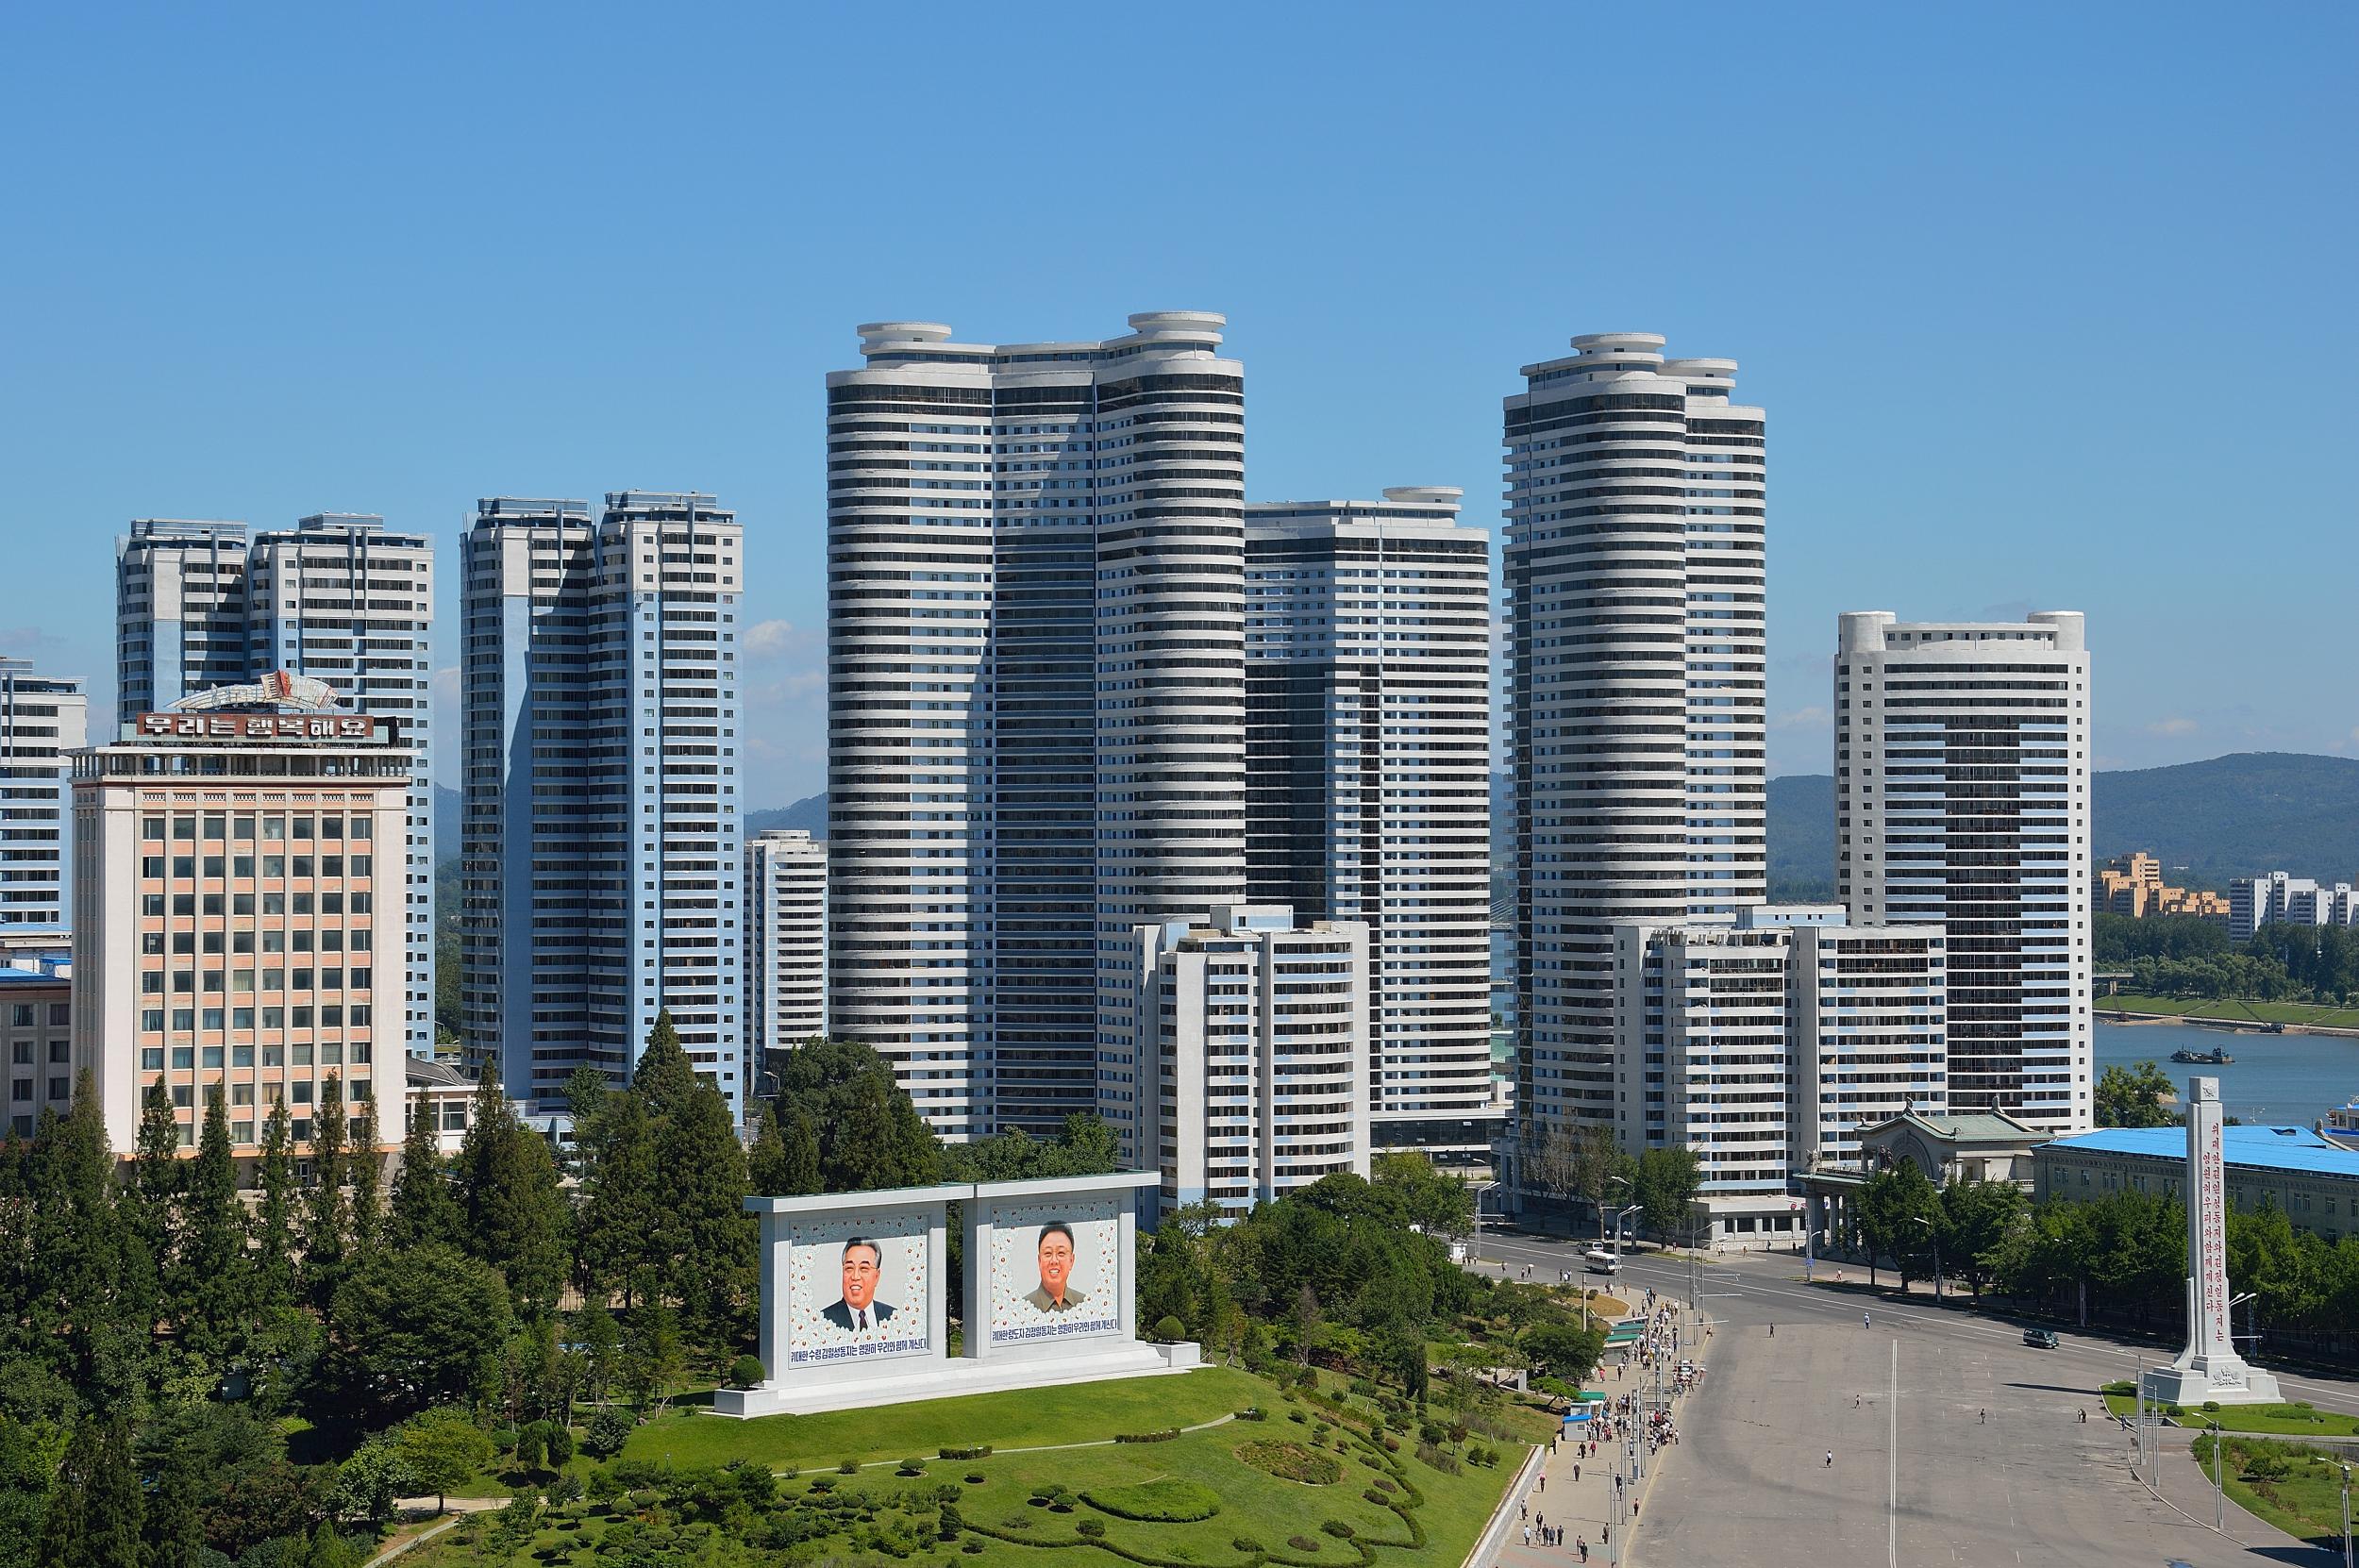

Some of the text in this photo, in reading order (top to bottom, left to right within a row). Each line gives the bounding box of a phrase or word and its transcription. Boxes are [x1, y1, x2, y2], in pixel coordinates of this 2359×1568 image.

[145, 716, 367, 736] 우리는 행복해요
[2211, 1123, 2220, 1164] 위대한
[2202, 1152, 2211, 1194] 영원히
[2203, 1195, 2212, 1239] 우리와
[1008, 1328, 1025, 1340] 령도자
[1058, 1323, 1074, 1335] 영원히
[1074, 1322, 1090, 1333] 우리와
[809, 1349, 822, 1360] 수령
[822, 1345, 858, 1359] 김일성동지는
[859, 1343, 877, 1355] 영원히
[877, 1342, 895, 1353] 우리와
[895, 1340, 908, 1351] 함께
[908, 1338, 927, 1350] 계신다
